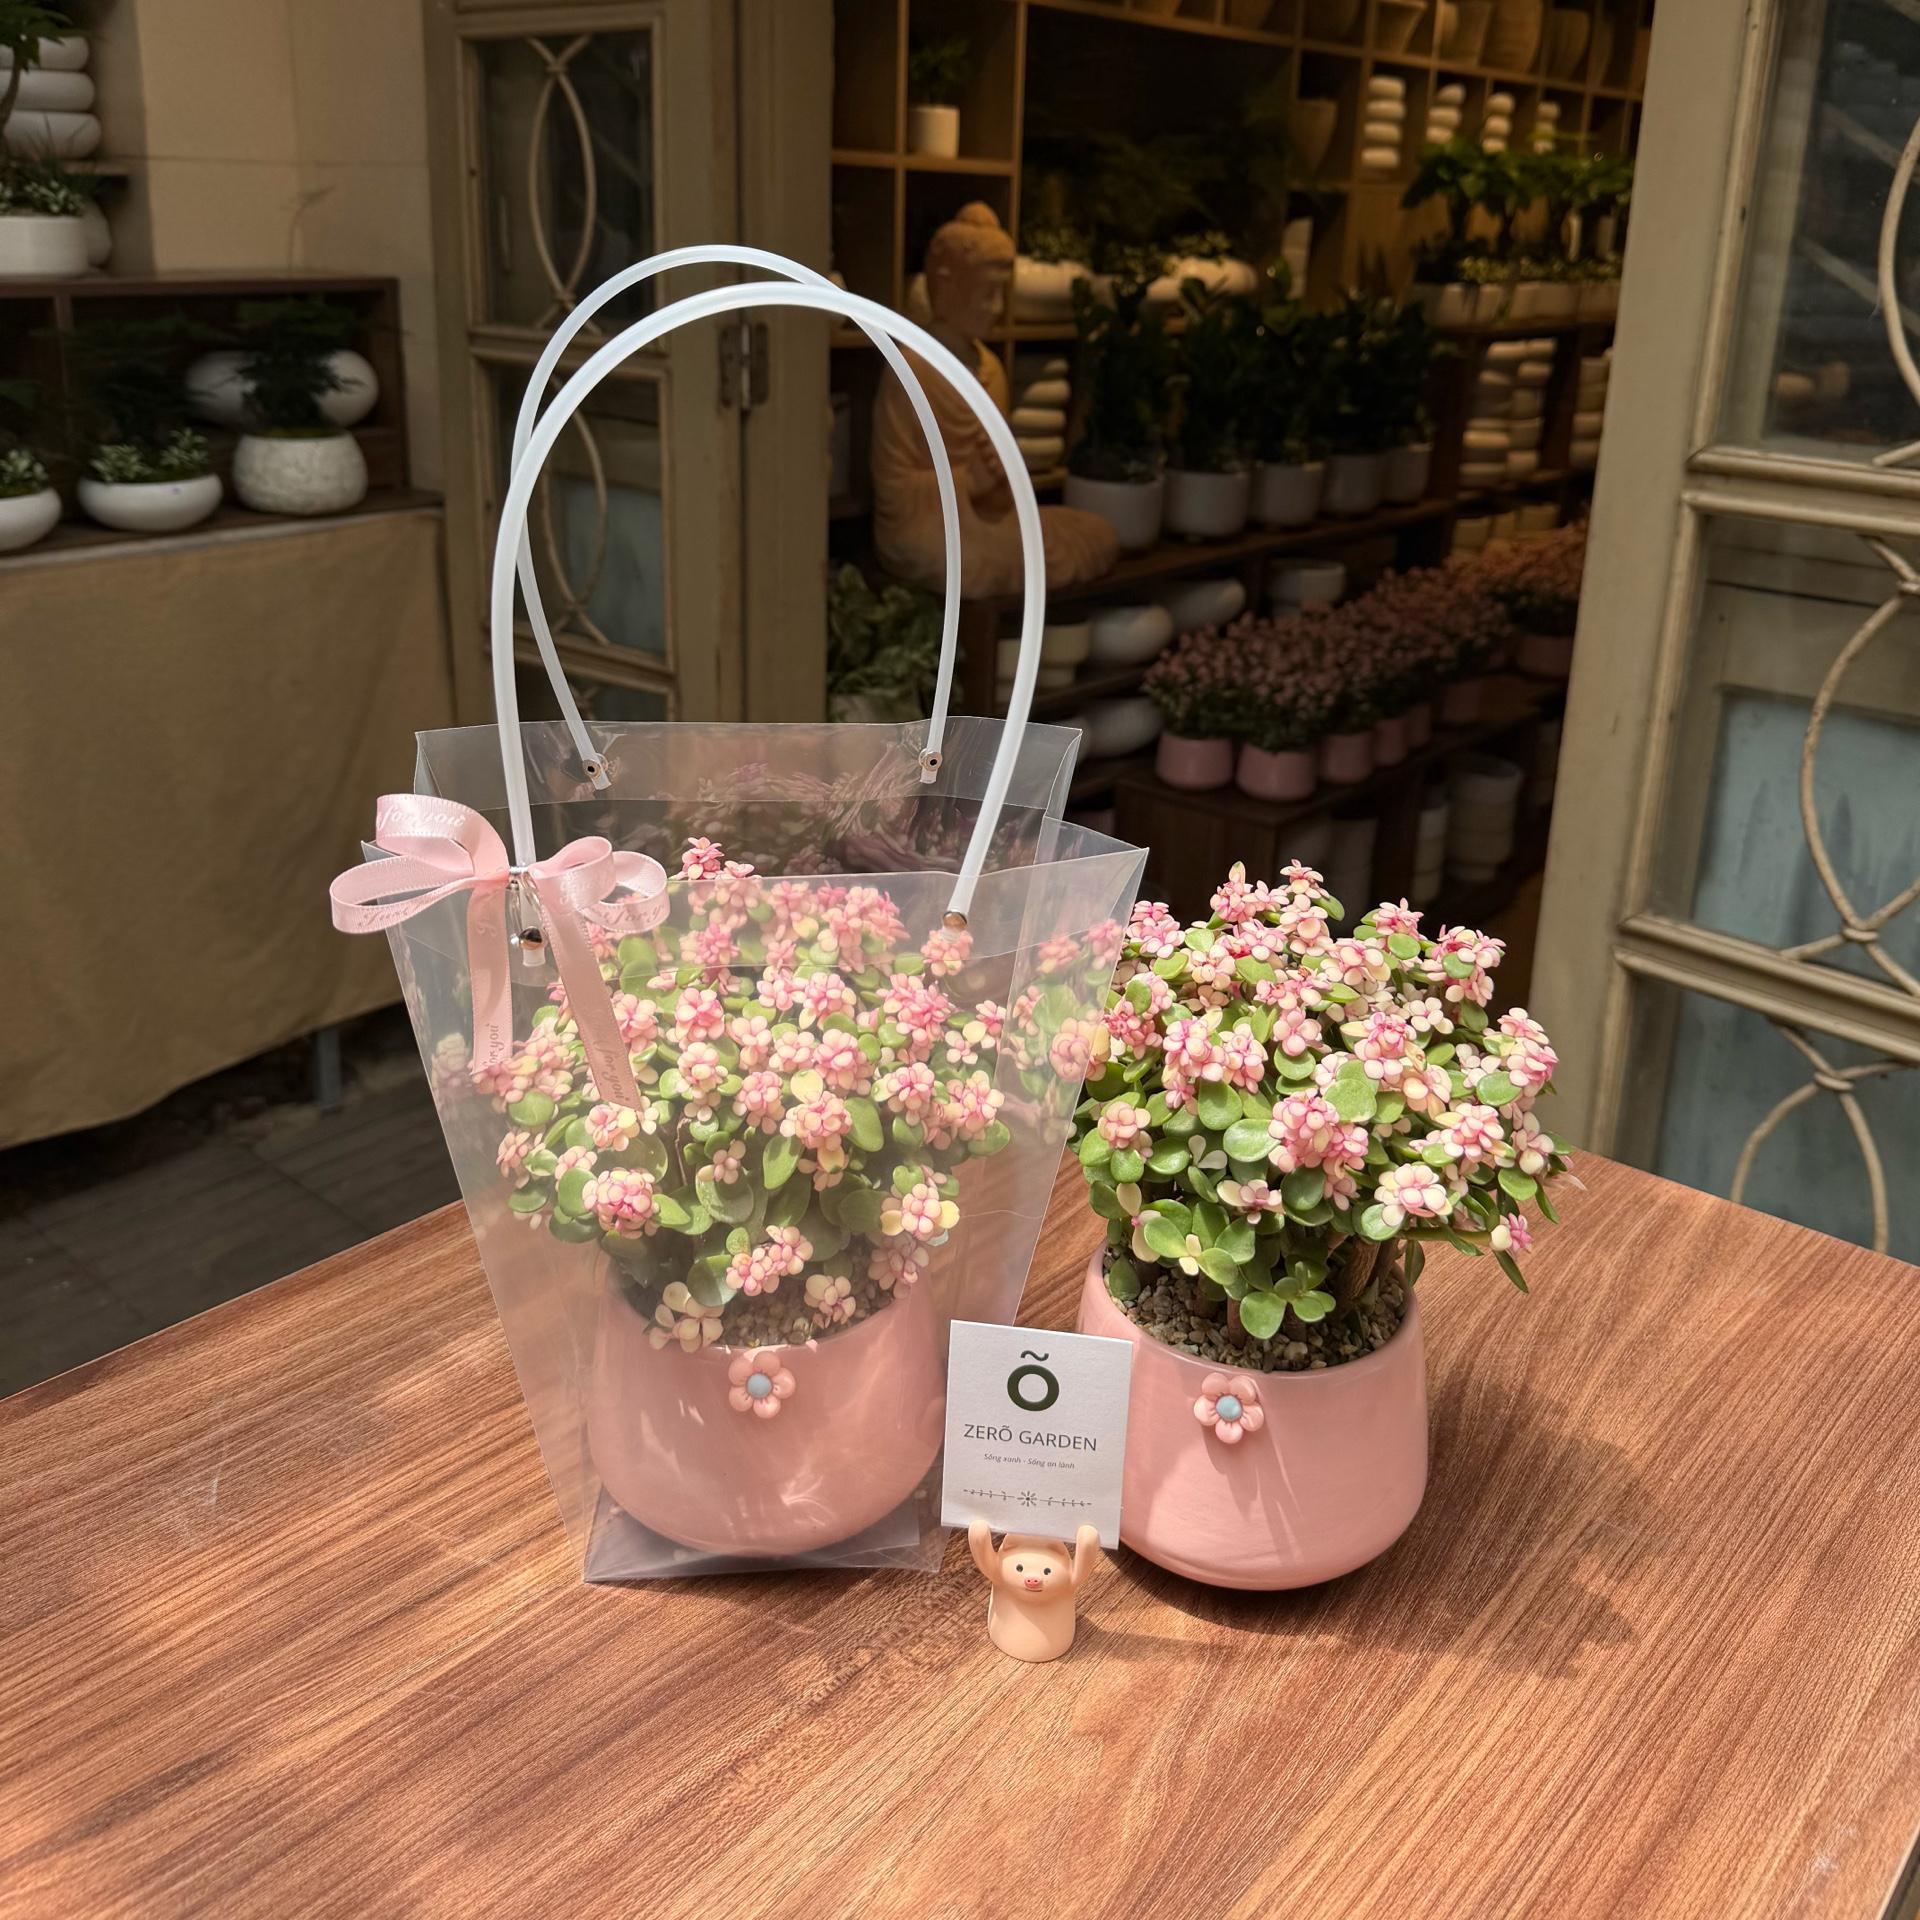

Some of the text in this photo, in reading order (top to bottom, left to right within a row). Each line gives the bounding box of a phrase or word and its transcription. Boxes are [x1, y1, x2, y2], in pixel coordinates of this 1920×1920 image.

[485, 1023, 505, 1051] you
[602, 1071, 630, 1101] you
[964, 1424, 1097, 1451] ZERÕ GARDEN
